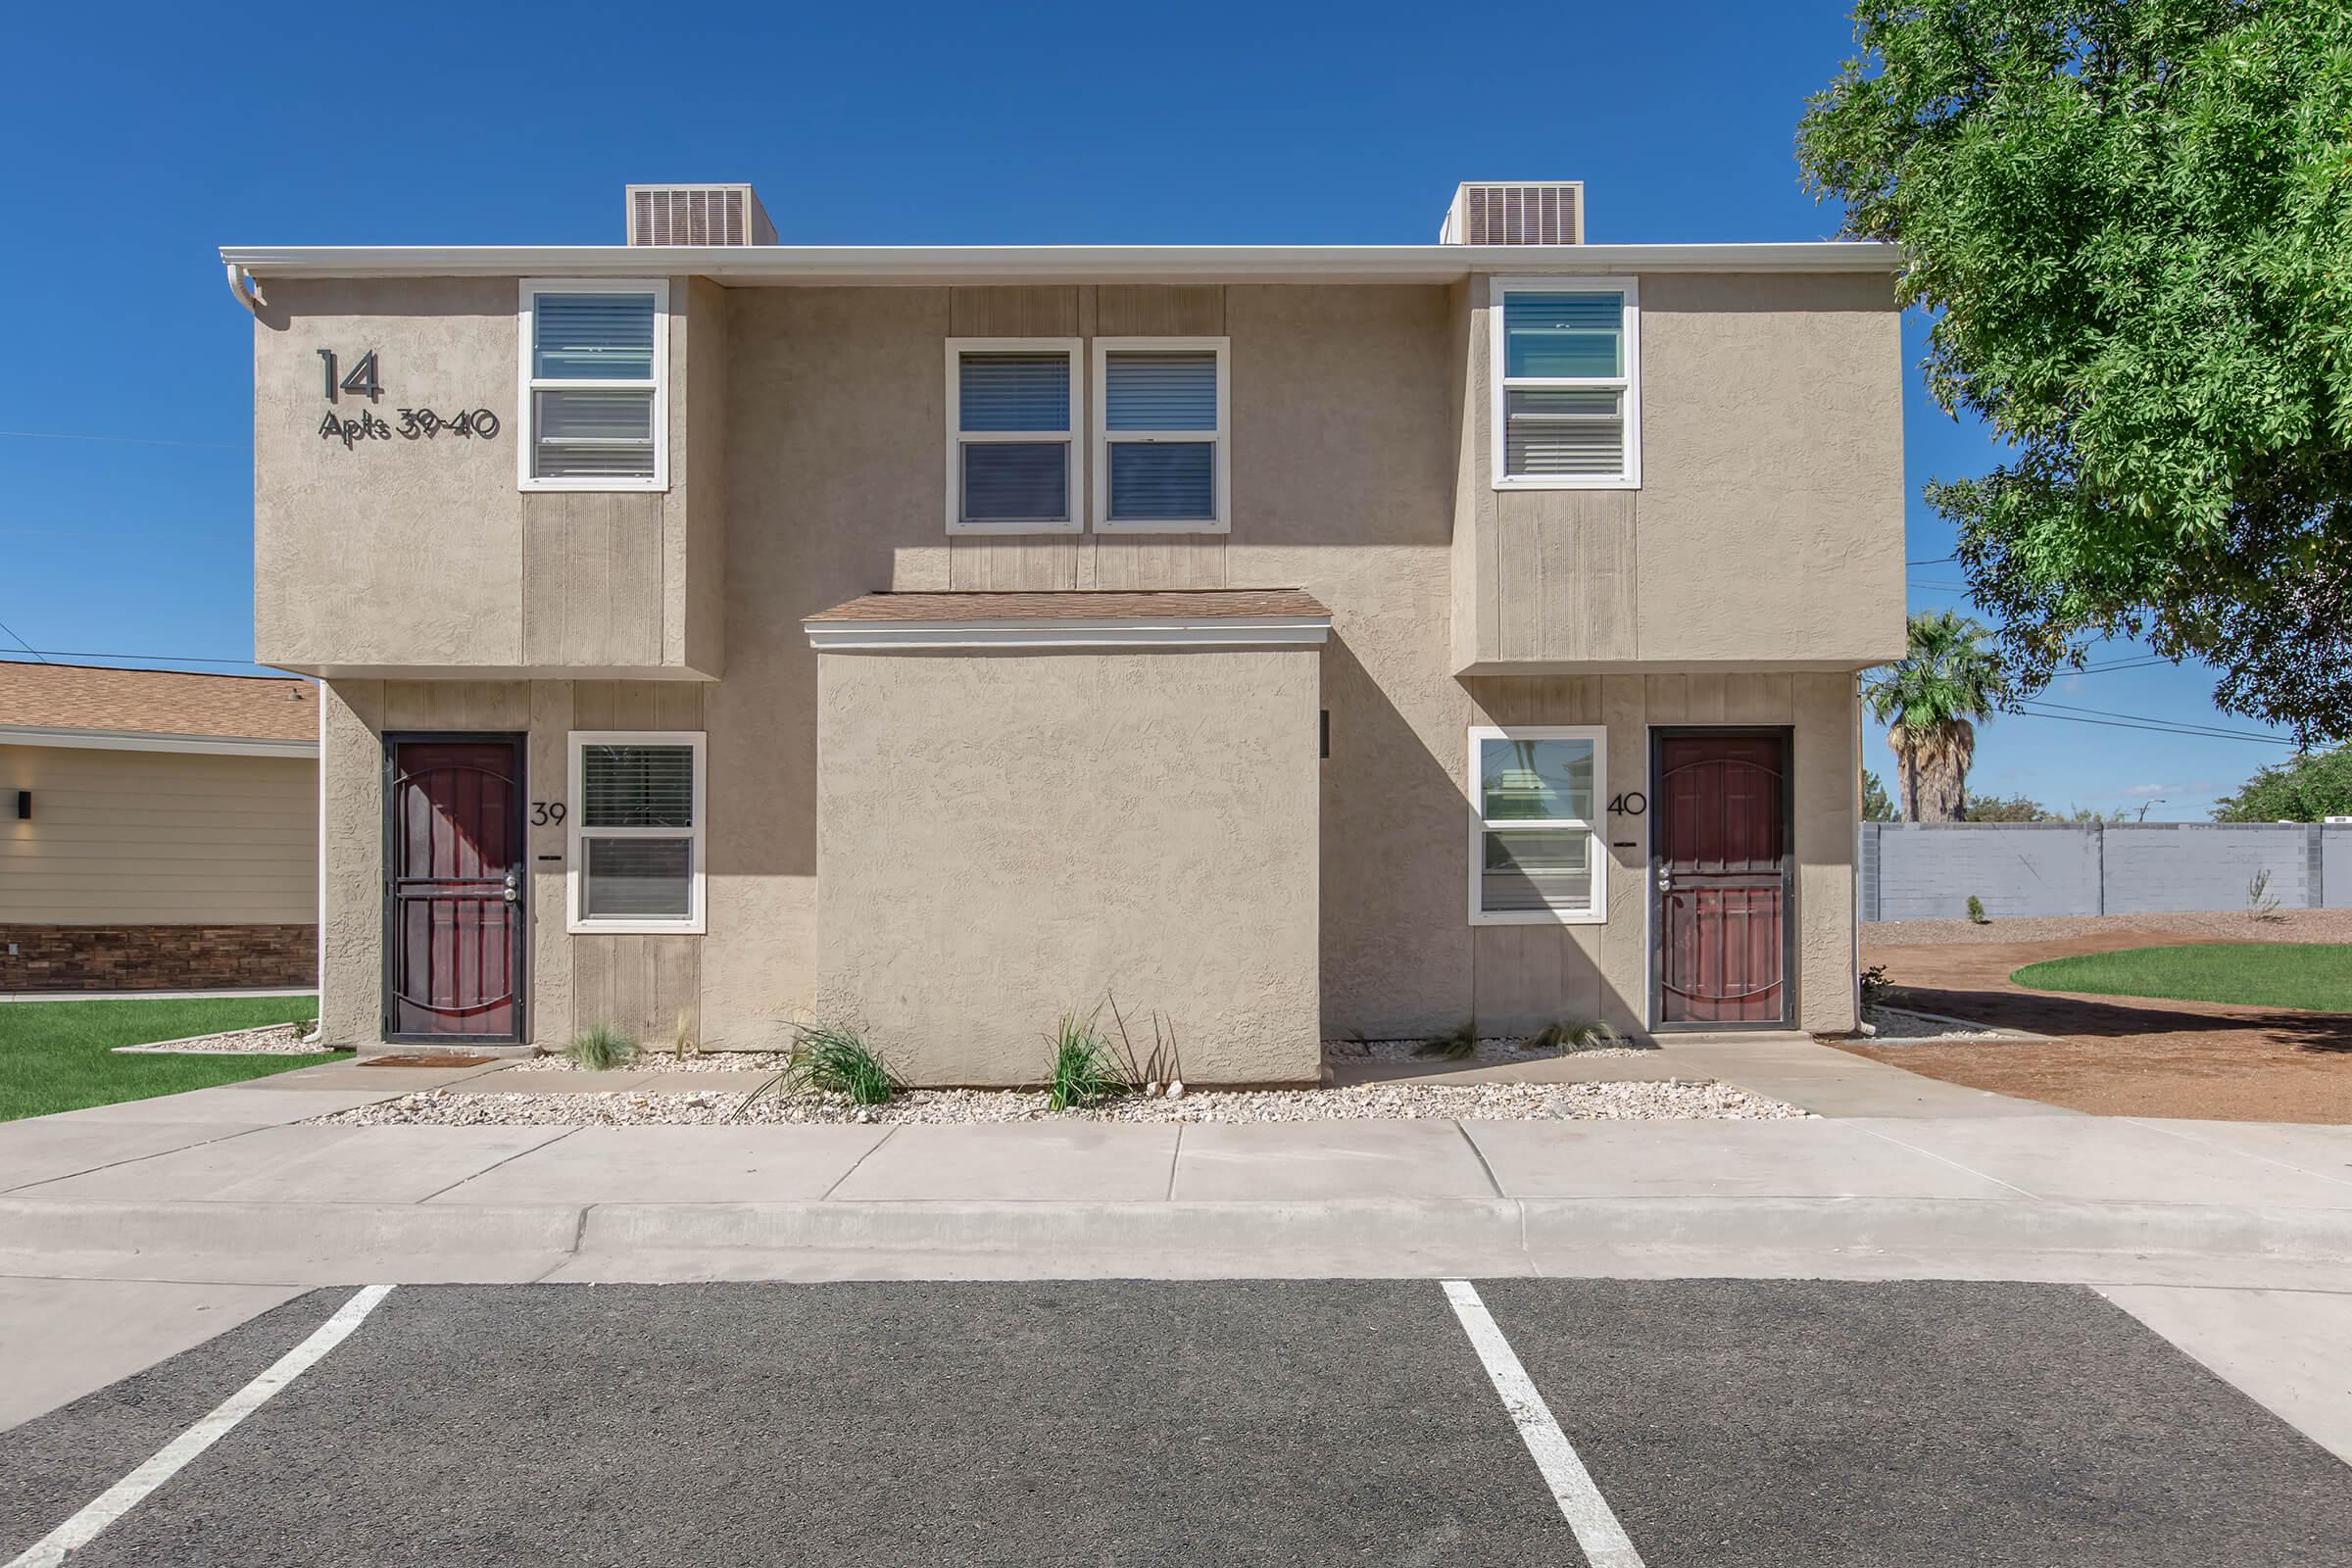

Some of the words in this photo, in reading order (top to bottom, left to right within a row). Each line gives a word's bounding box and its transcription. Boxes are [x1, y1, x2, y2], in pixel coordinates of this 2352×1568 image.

[317, 349, 379, 399] 14
[318, 409, 388, 446] Apts
[396, 408, 497, 435] 39-40
[530, 802, 566, 826] 39
[1606, 792, 1646, 815] 40
